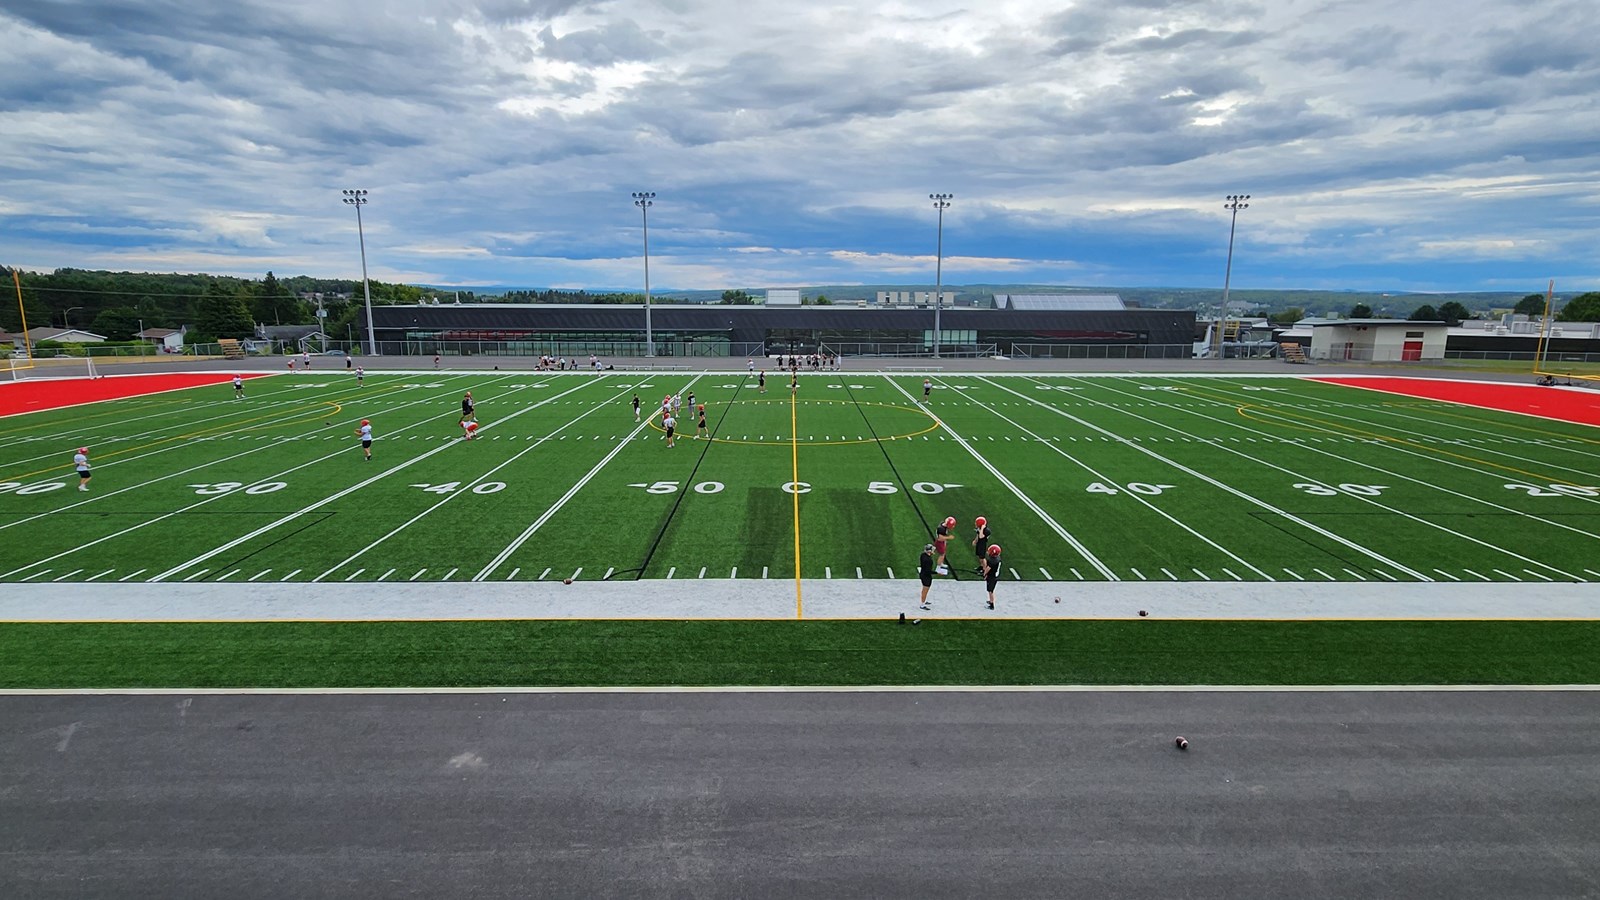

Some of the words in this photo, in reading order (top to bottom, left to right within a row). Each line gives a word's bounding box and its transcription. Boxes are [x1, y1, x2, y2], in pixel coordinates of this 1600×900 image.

[195, 482, 288, 495] 30
[422, 482, 507, 494] 40
[646, 482, 725, 494] 50
[867, 482, 944, 494] 50
[1085, 483, 1164, 495] 40
[1292, 484, 1382, 496] 30
[1503, 484, 1600, 496] 20
